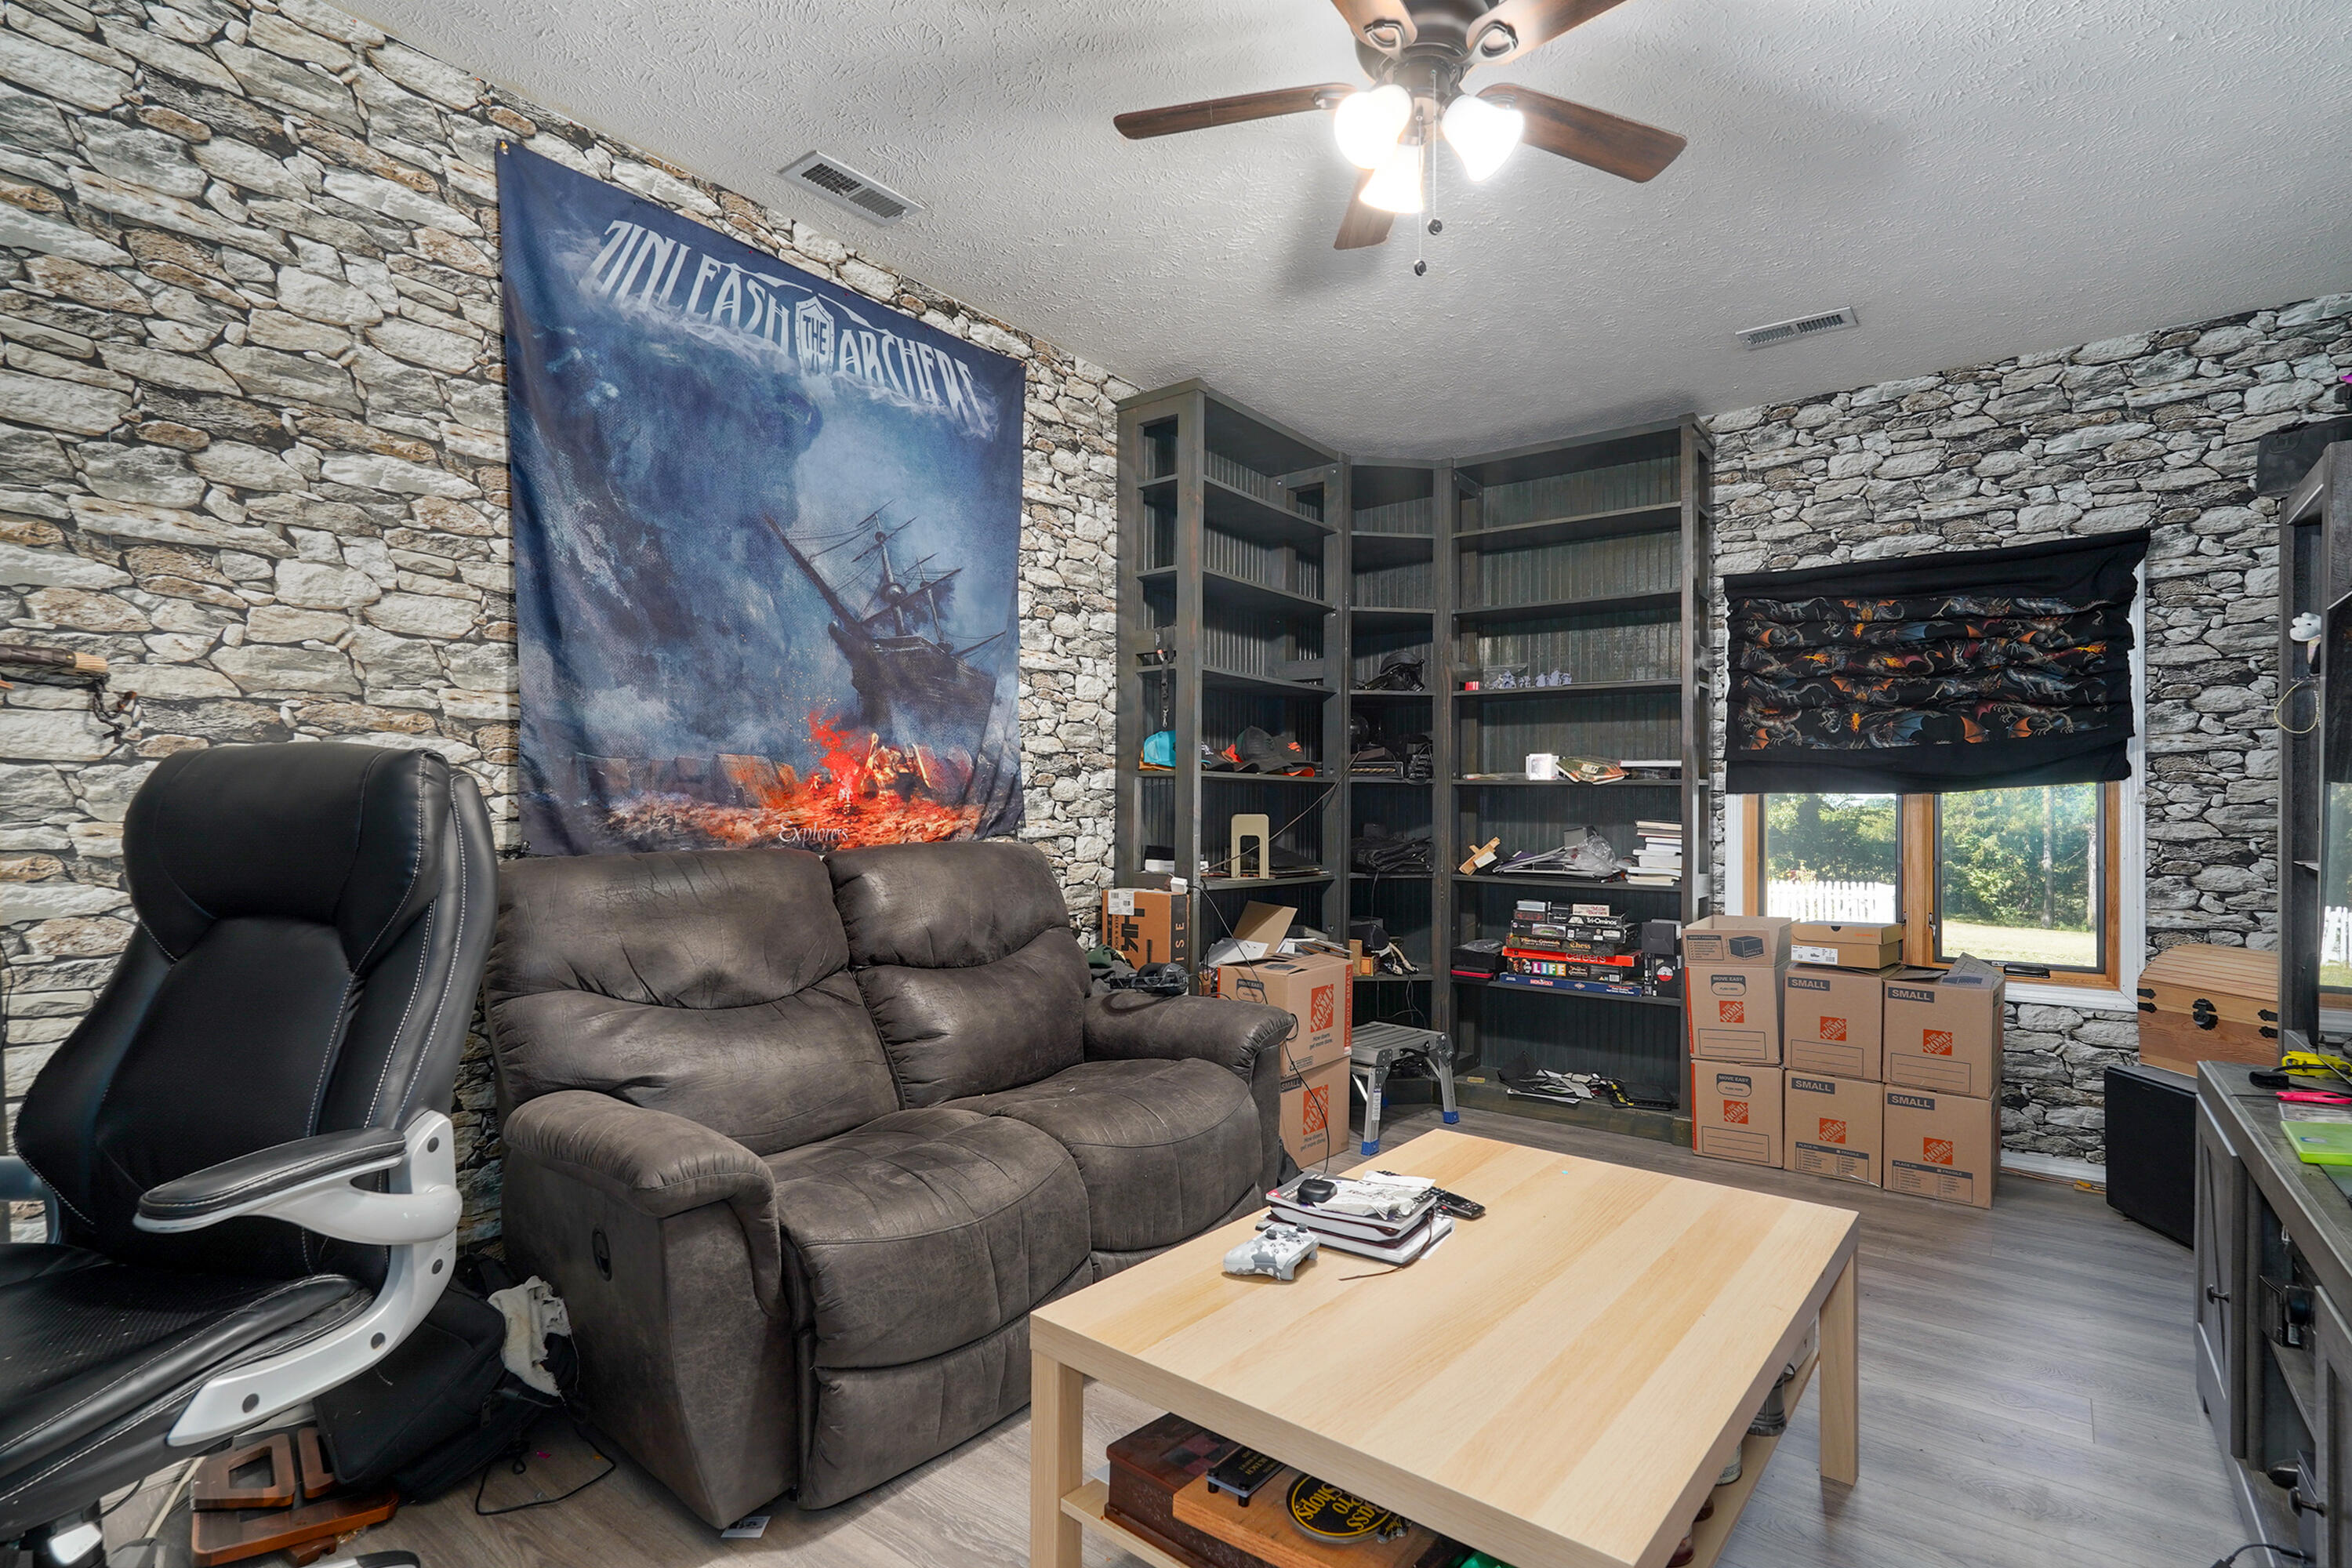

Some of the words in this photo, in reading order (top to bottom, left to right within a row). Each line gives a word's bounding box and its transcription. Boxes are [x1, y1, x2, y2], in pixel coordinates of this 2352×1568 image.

[801, 314, 829, 372] THE
[779, 820, 849, 846] Explorers
[1570, 941, 1592, 949] Chess
[1533, 963, 1565, 975] LIFE
[1791, 978, 1827, 989] SMALL
[1892, 989, 1931, 1000] SMALL
[1281, 1080, 1301, 1091] SMALL
[1795, 1080, 1831, 1092] SMALL
[1891, 1095, 1931, 1108] SMALL
[1296, 1482, 1343, 1521] Shops
